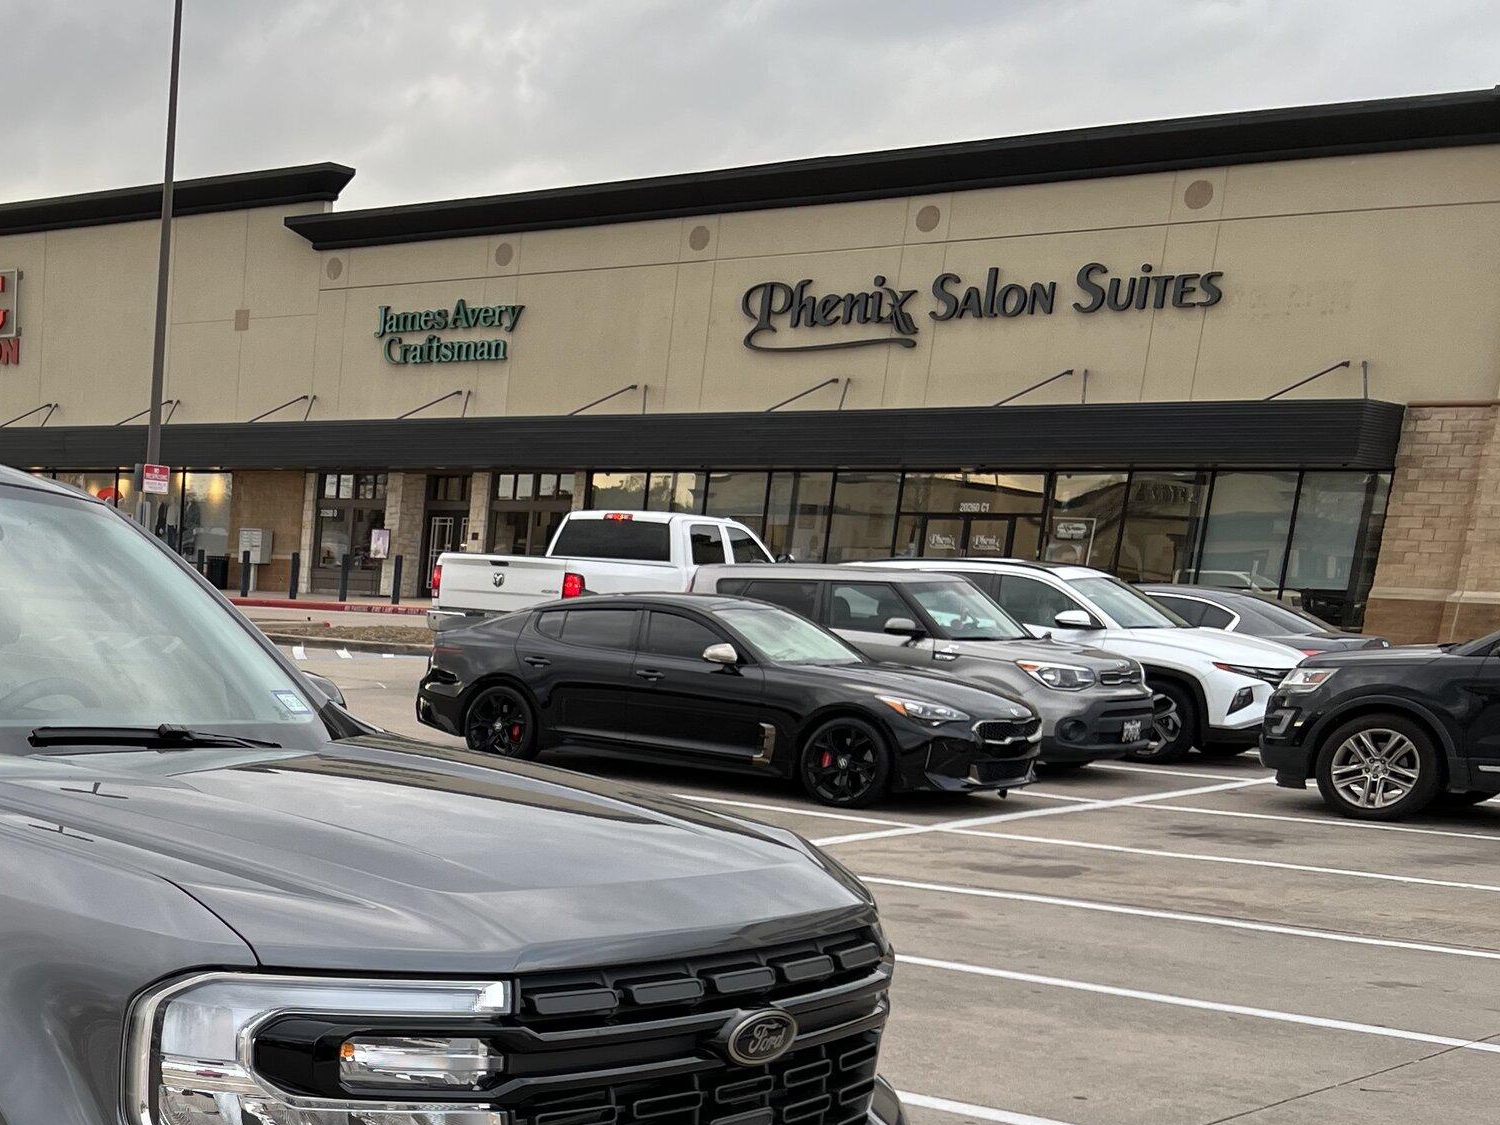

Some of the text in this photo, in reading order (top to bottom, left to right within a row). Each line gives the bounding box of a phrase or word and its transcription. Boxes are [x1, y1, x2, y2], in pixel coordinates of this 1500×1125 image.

[374, 298, 525, 338] James Avery
[742, 275, 919, 351] Phenix
[383, 335, 508, 365] Craftsman
[748, 1020, 786, 1054] Ford
